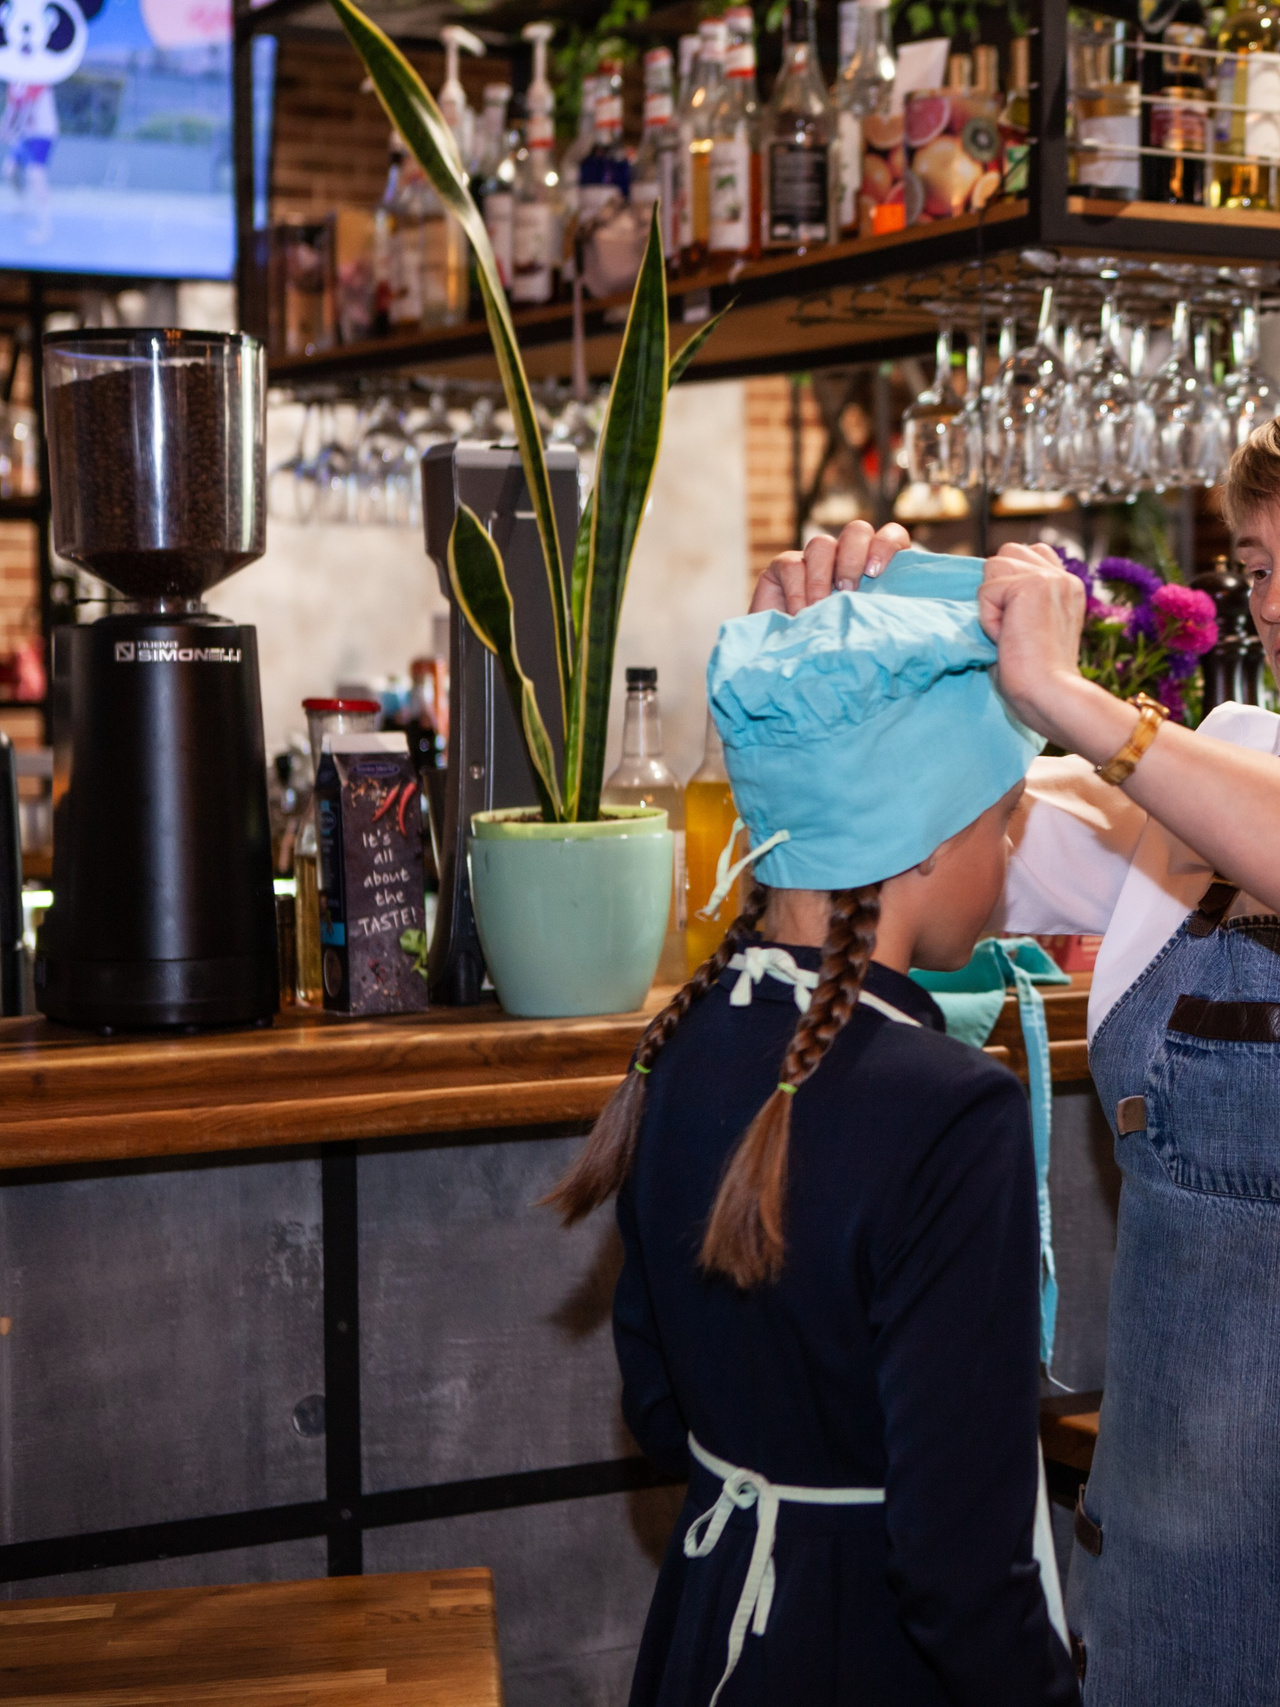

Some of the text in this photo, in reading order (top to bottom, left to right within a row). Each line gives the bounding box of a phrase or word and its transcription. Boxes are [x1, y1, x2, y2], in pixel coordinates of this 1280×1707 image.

[362, 829, 391, 848] It's
[373, 848, 393, 865] all
[363, 867, 411, 888] about
[375, 888, 405, 907] the
[358, 906, 417, 937] TASTE!
